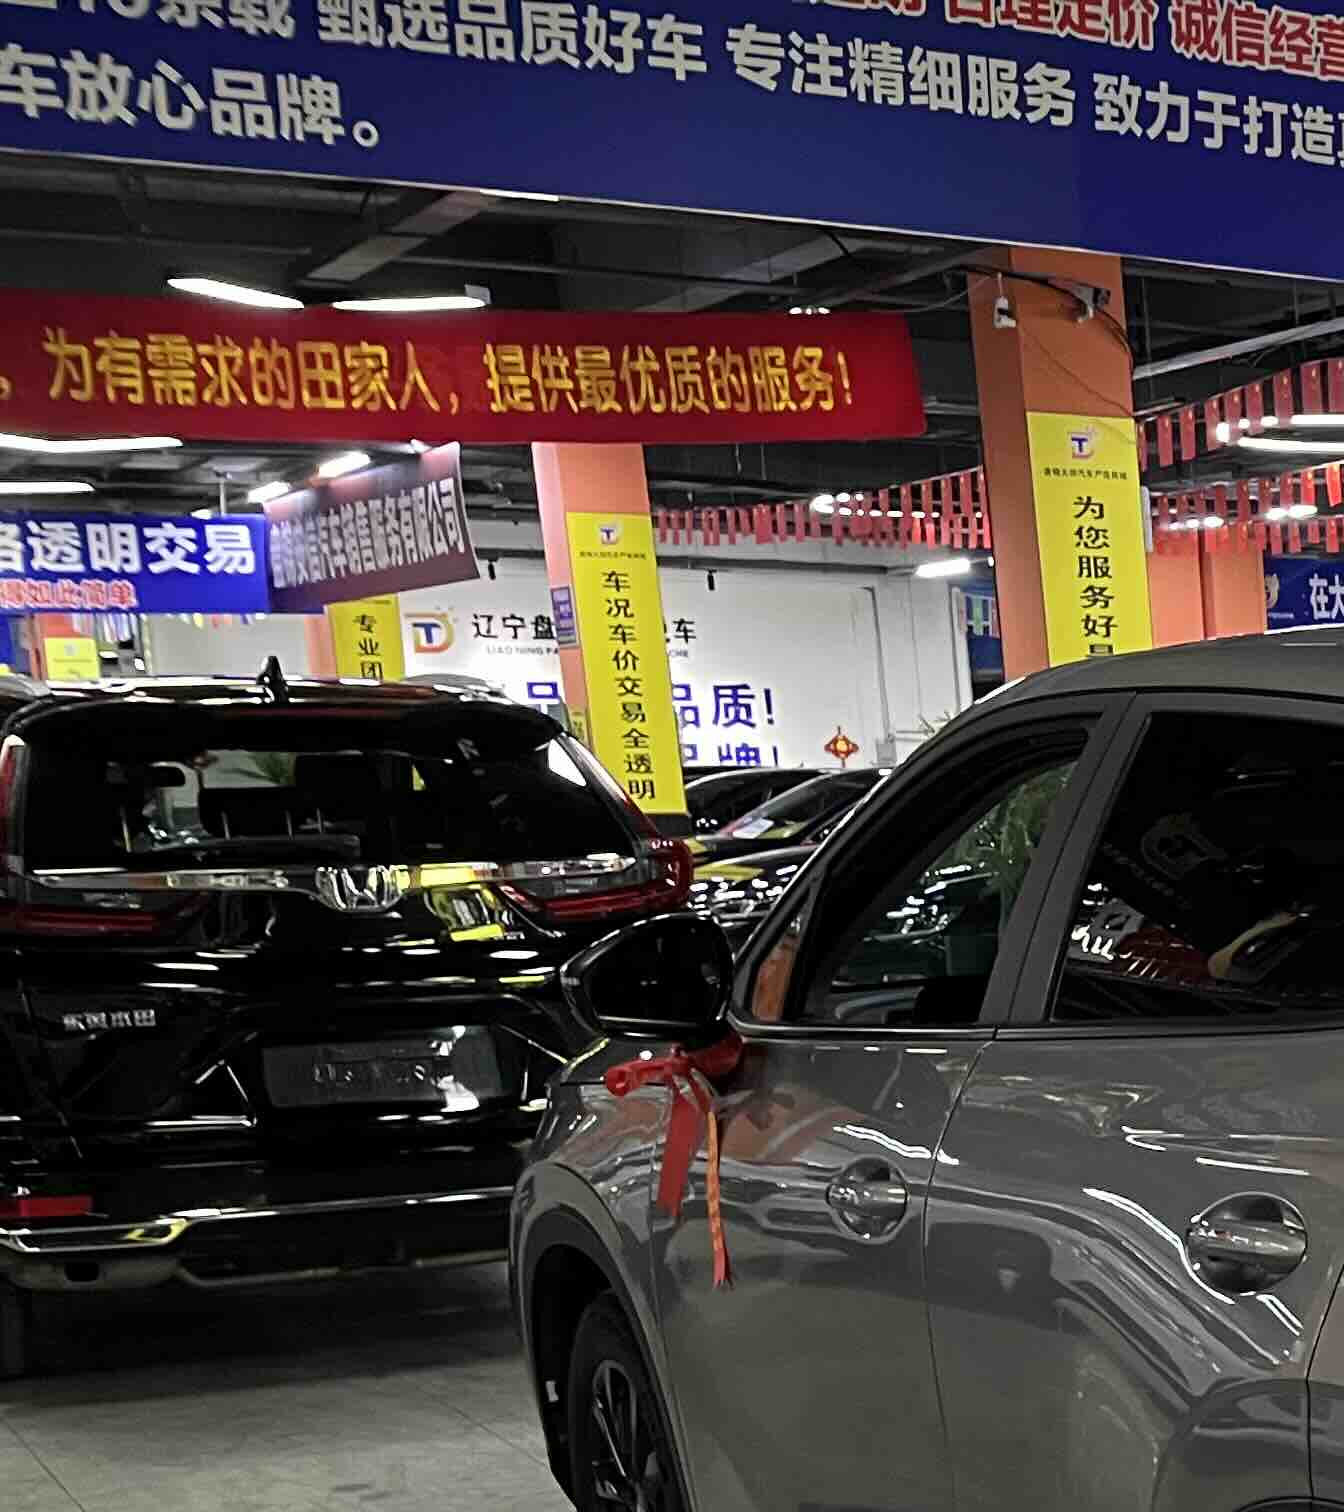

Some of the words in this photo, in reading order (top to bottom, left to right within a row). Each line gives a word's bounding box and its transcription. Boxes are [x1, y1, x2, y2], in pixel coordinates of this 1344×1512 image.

[0, 43, 380, 147] 车放心品牌。
[317, 0, 708, 82] 甄选品质好车
[724, 23, 1076, 127] 专注精细服务
[601, 569, 657, 801] 车况车价交易全透明
